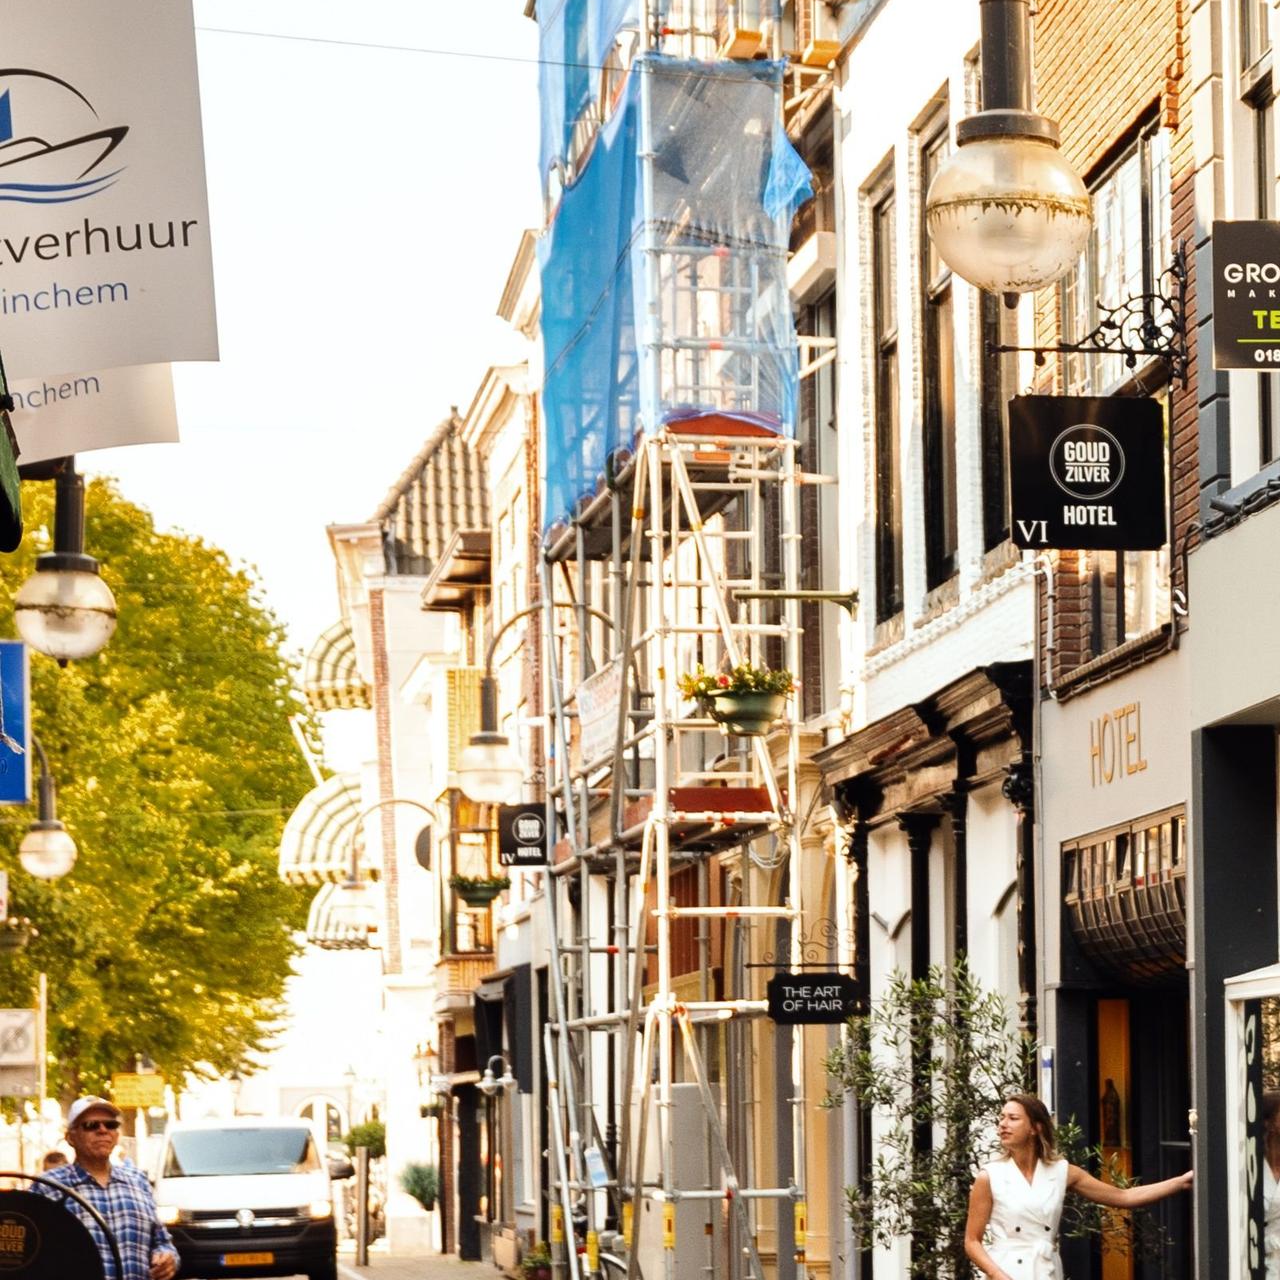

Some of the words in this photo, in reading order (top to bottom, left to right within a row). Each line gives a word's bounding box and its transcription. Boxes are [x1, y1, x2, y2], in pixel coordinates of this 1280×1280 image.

[0, 218, 198, 266] verhuur
[2, 281, 129, 315] inchem
[1063, 440, 1110, 463] GOUD
[1065, 464, 1110, 484] ZILVER
[1063, 505, 1118, 527] HOTEL
[1016, 520, 1049, 543] VI
[1089, 700, 1148, 788] HOTEL
[501, 853, 515, 865] IV
[782, 986, 811, 998] THE
[813, 986, 842, 998] ART
[782, 1000, 804, 1012] OF
[807, 1000, 843, 1011] HAIR
[0, 1224, 26, 1238] OUD
